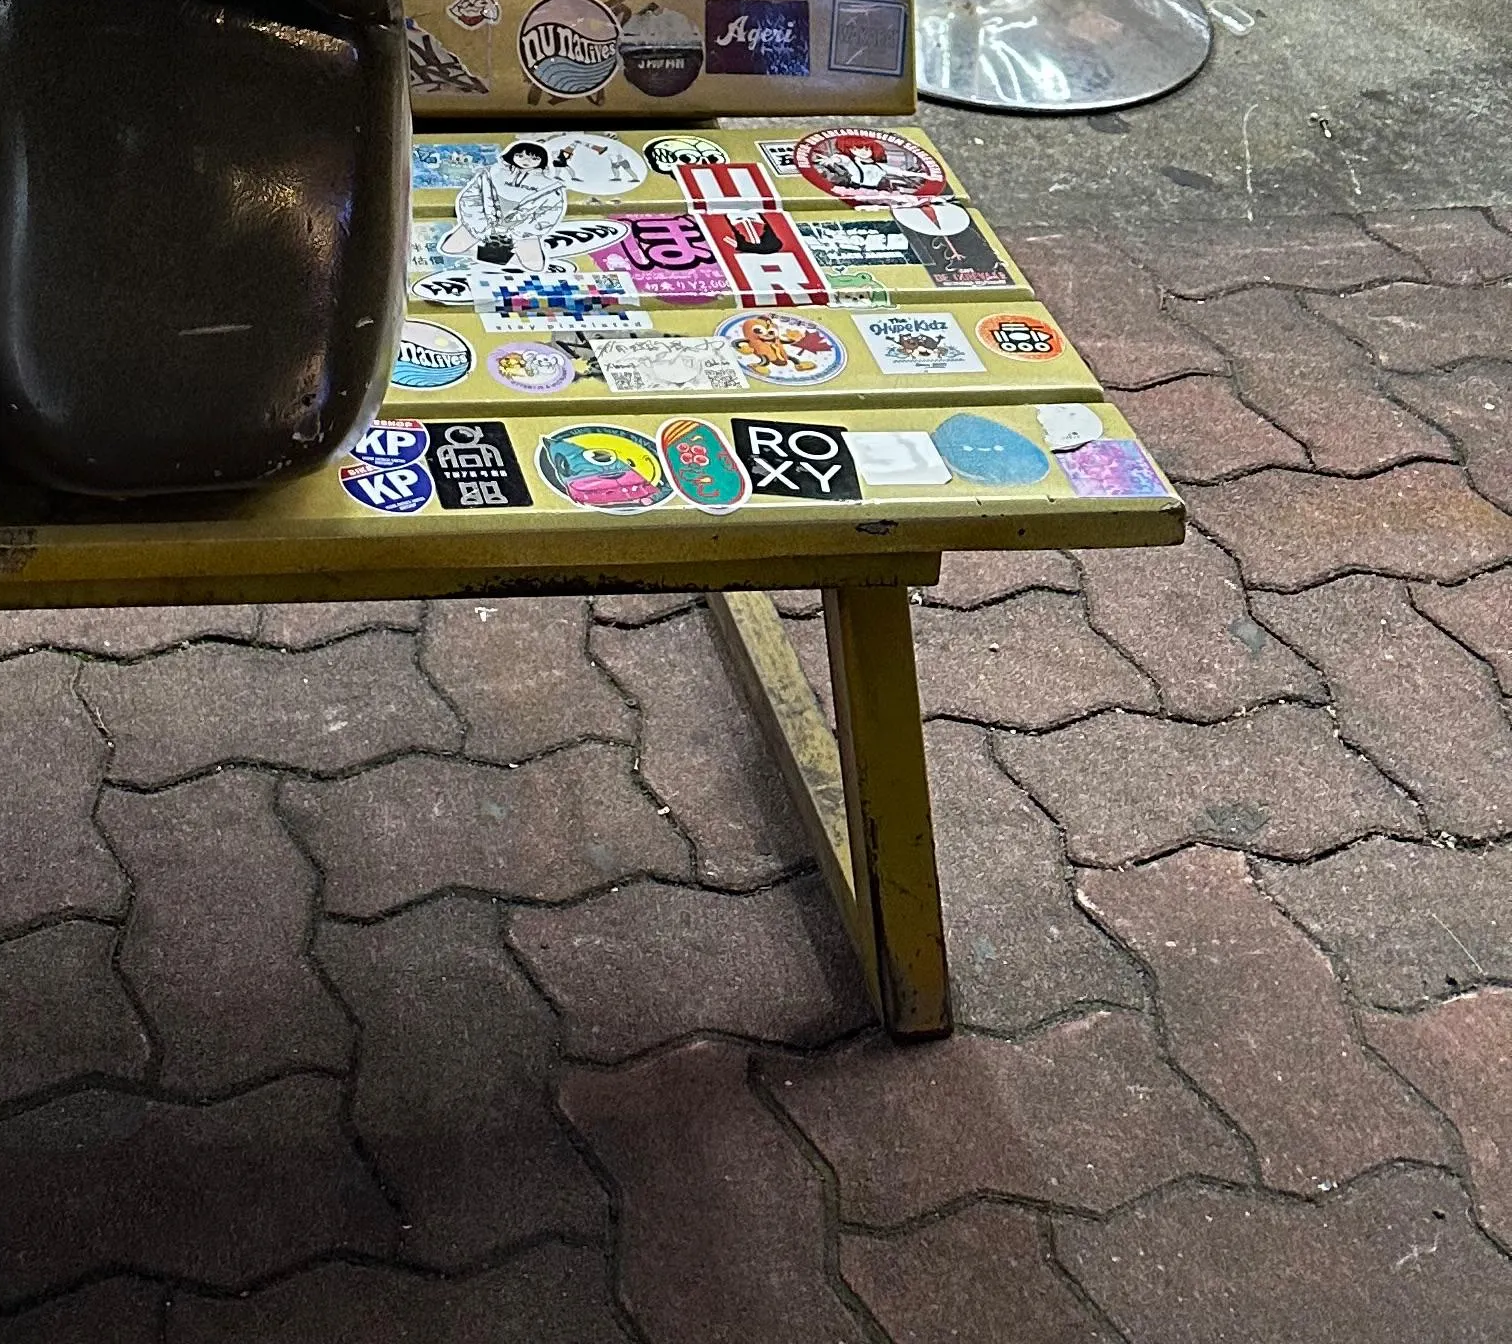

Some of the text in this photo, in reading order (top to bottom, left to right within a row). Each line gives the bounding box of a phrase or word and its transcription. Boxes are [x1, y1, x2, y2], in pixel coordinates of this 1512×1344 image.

[716, 15, 794, 51] Ageri
[889, 317, 908, 325] The
[356, 429, 417, 457] KP
[748, 426, 839, 461] RO
[358, 469, 420, 505] KP
[756, 459, 842, 493] XY
